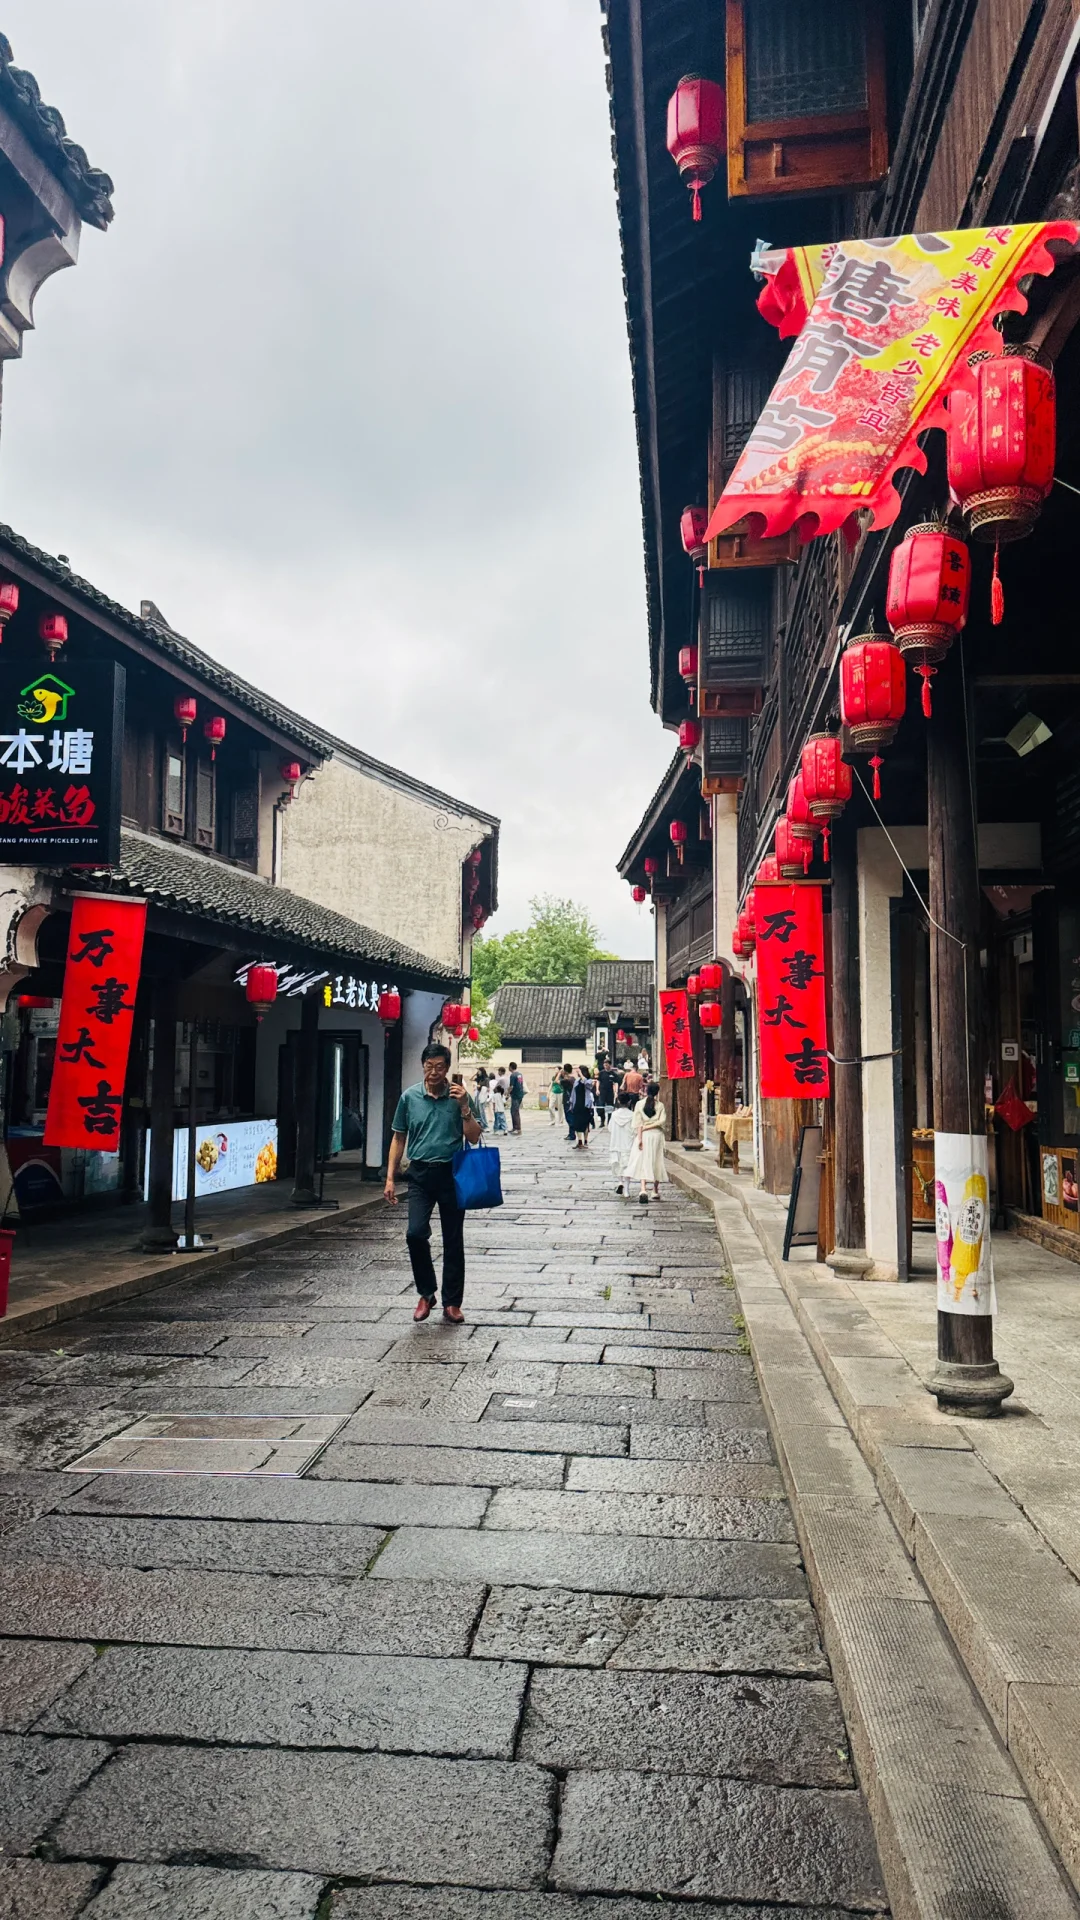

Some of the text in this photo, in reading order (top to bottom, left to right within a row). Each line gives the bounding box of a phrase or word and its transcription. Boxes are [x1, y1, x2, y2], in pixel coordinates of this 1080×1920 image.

[858, 333, 942, 433] 老少皆宜
[0, 728, 94, 774] 本塘
[59, 929, 135, 1135] 万事大吉
[332, 975, 399, 1012] 王老汉臭
[759, 910, 828, 1084] 万事大吉
[663, 1001, 693, 1072] 万事大吉
